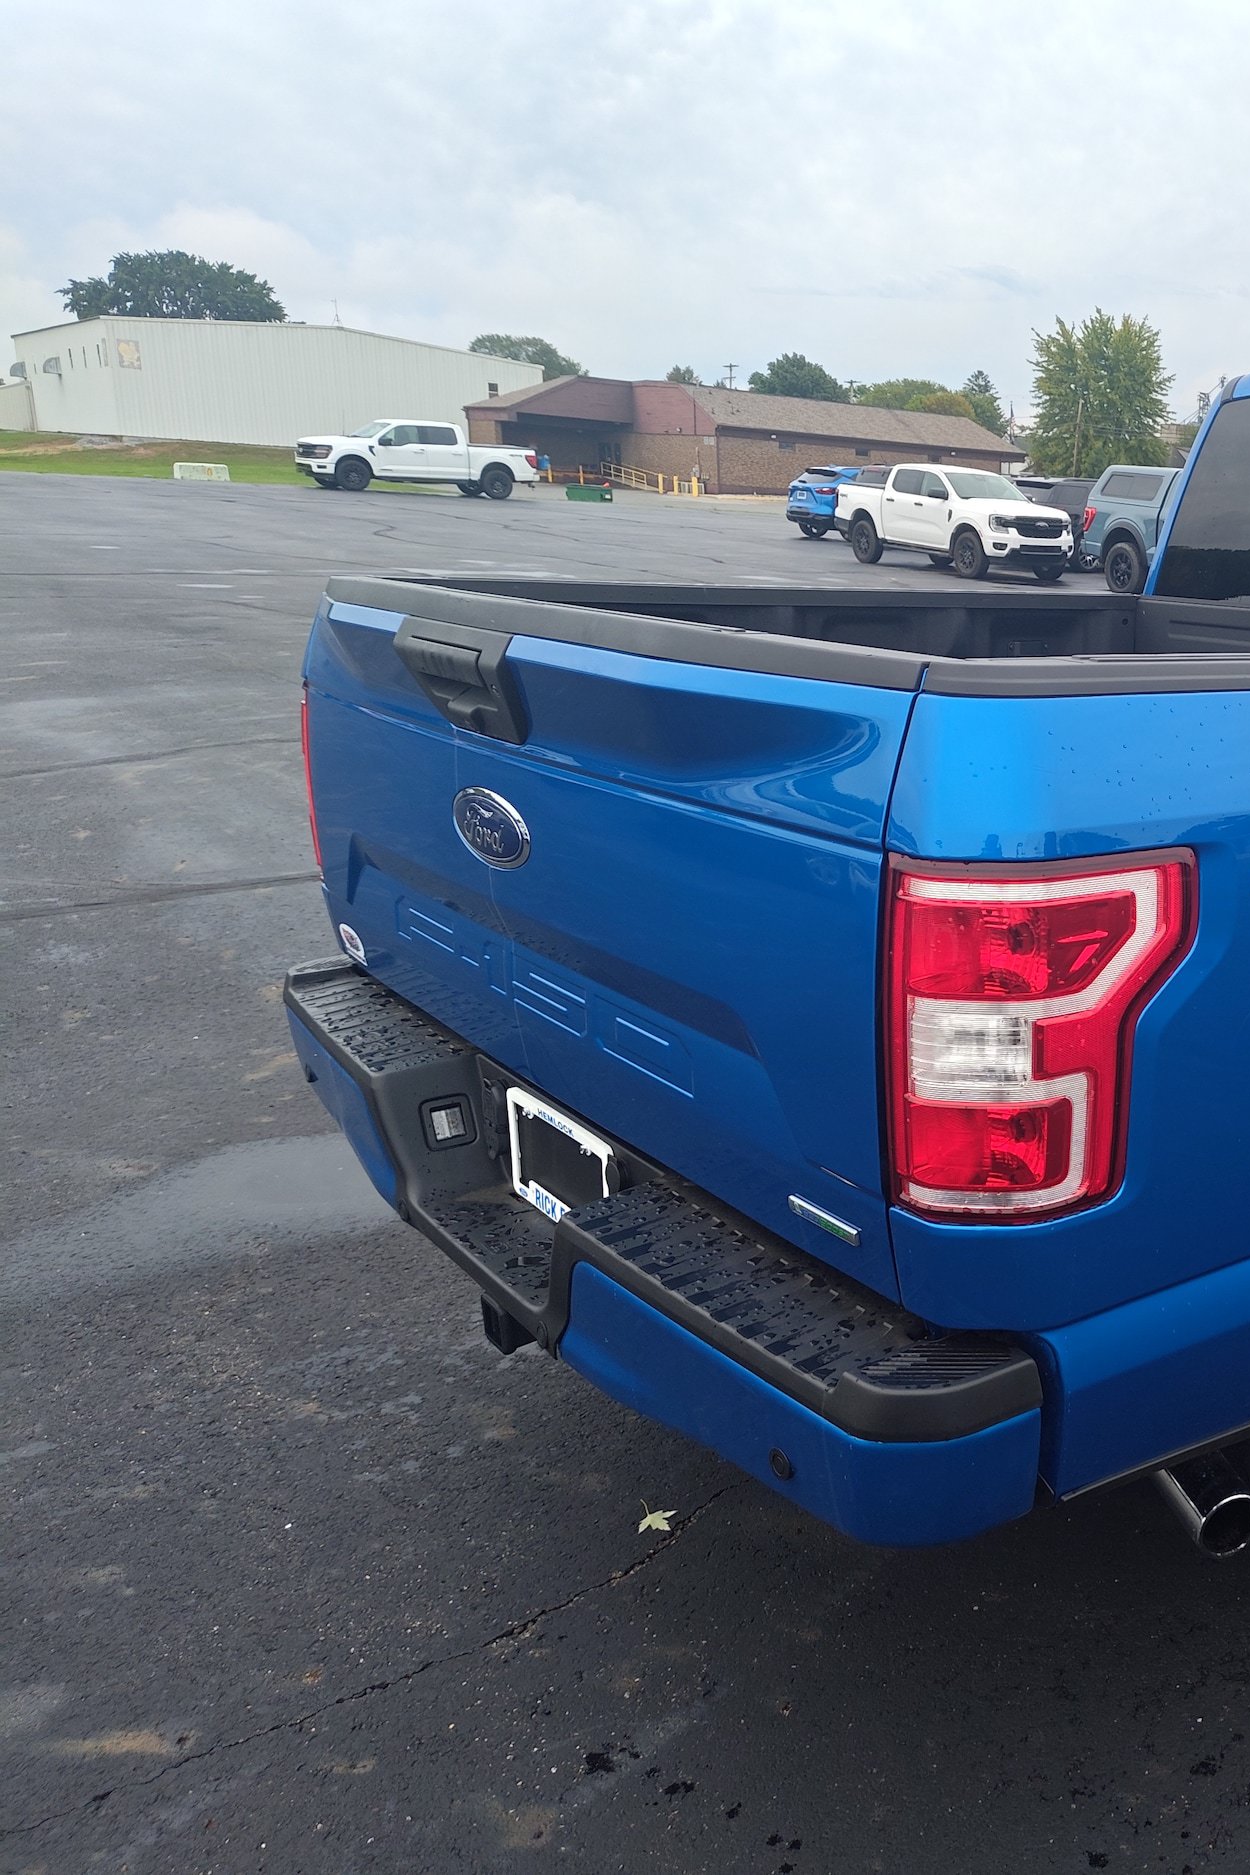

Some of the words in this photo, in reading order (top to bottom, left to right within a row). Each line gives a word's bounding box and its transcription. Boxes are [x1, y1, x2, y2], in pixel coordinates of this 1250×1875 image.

[463, 802, 505, 854] Ford
[536, 1107, 575, 1138] HEMLOCK
[535, 1187, 558, 1220] RICK
